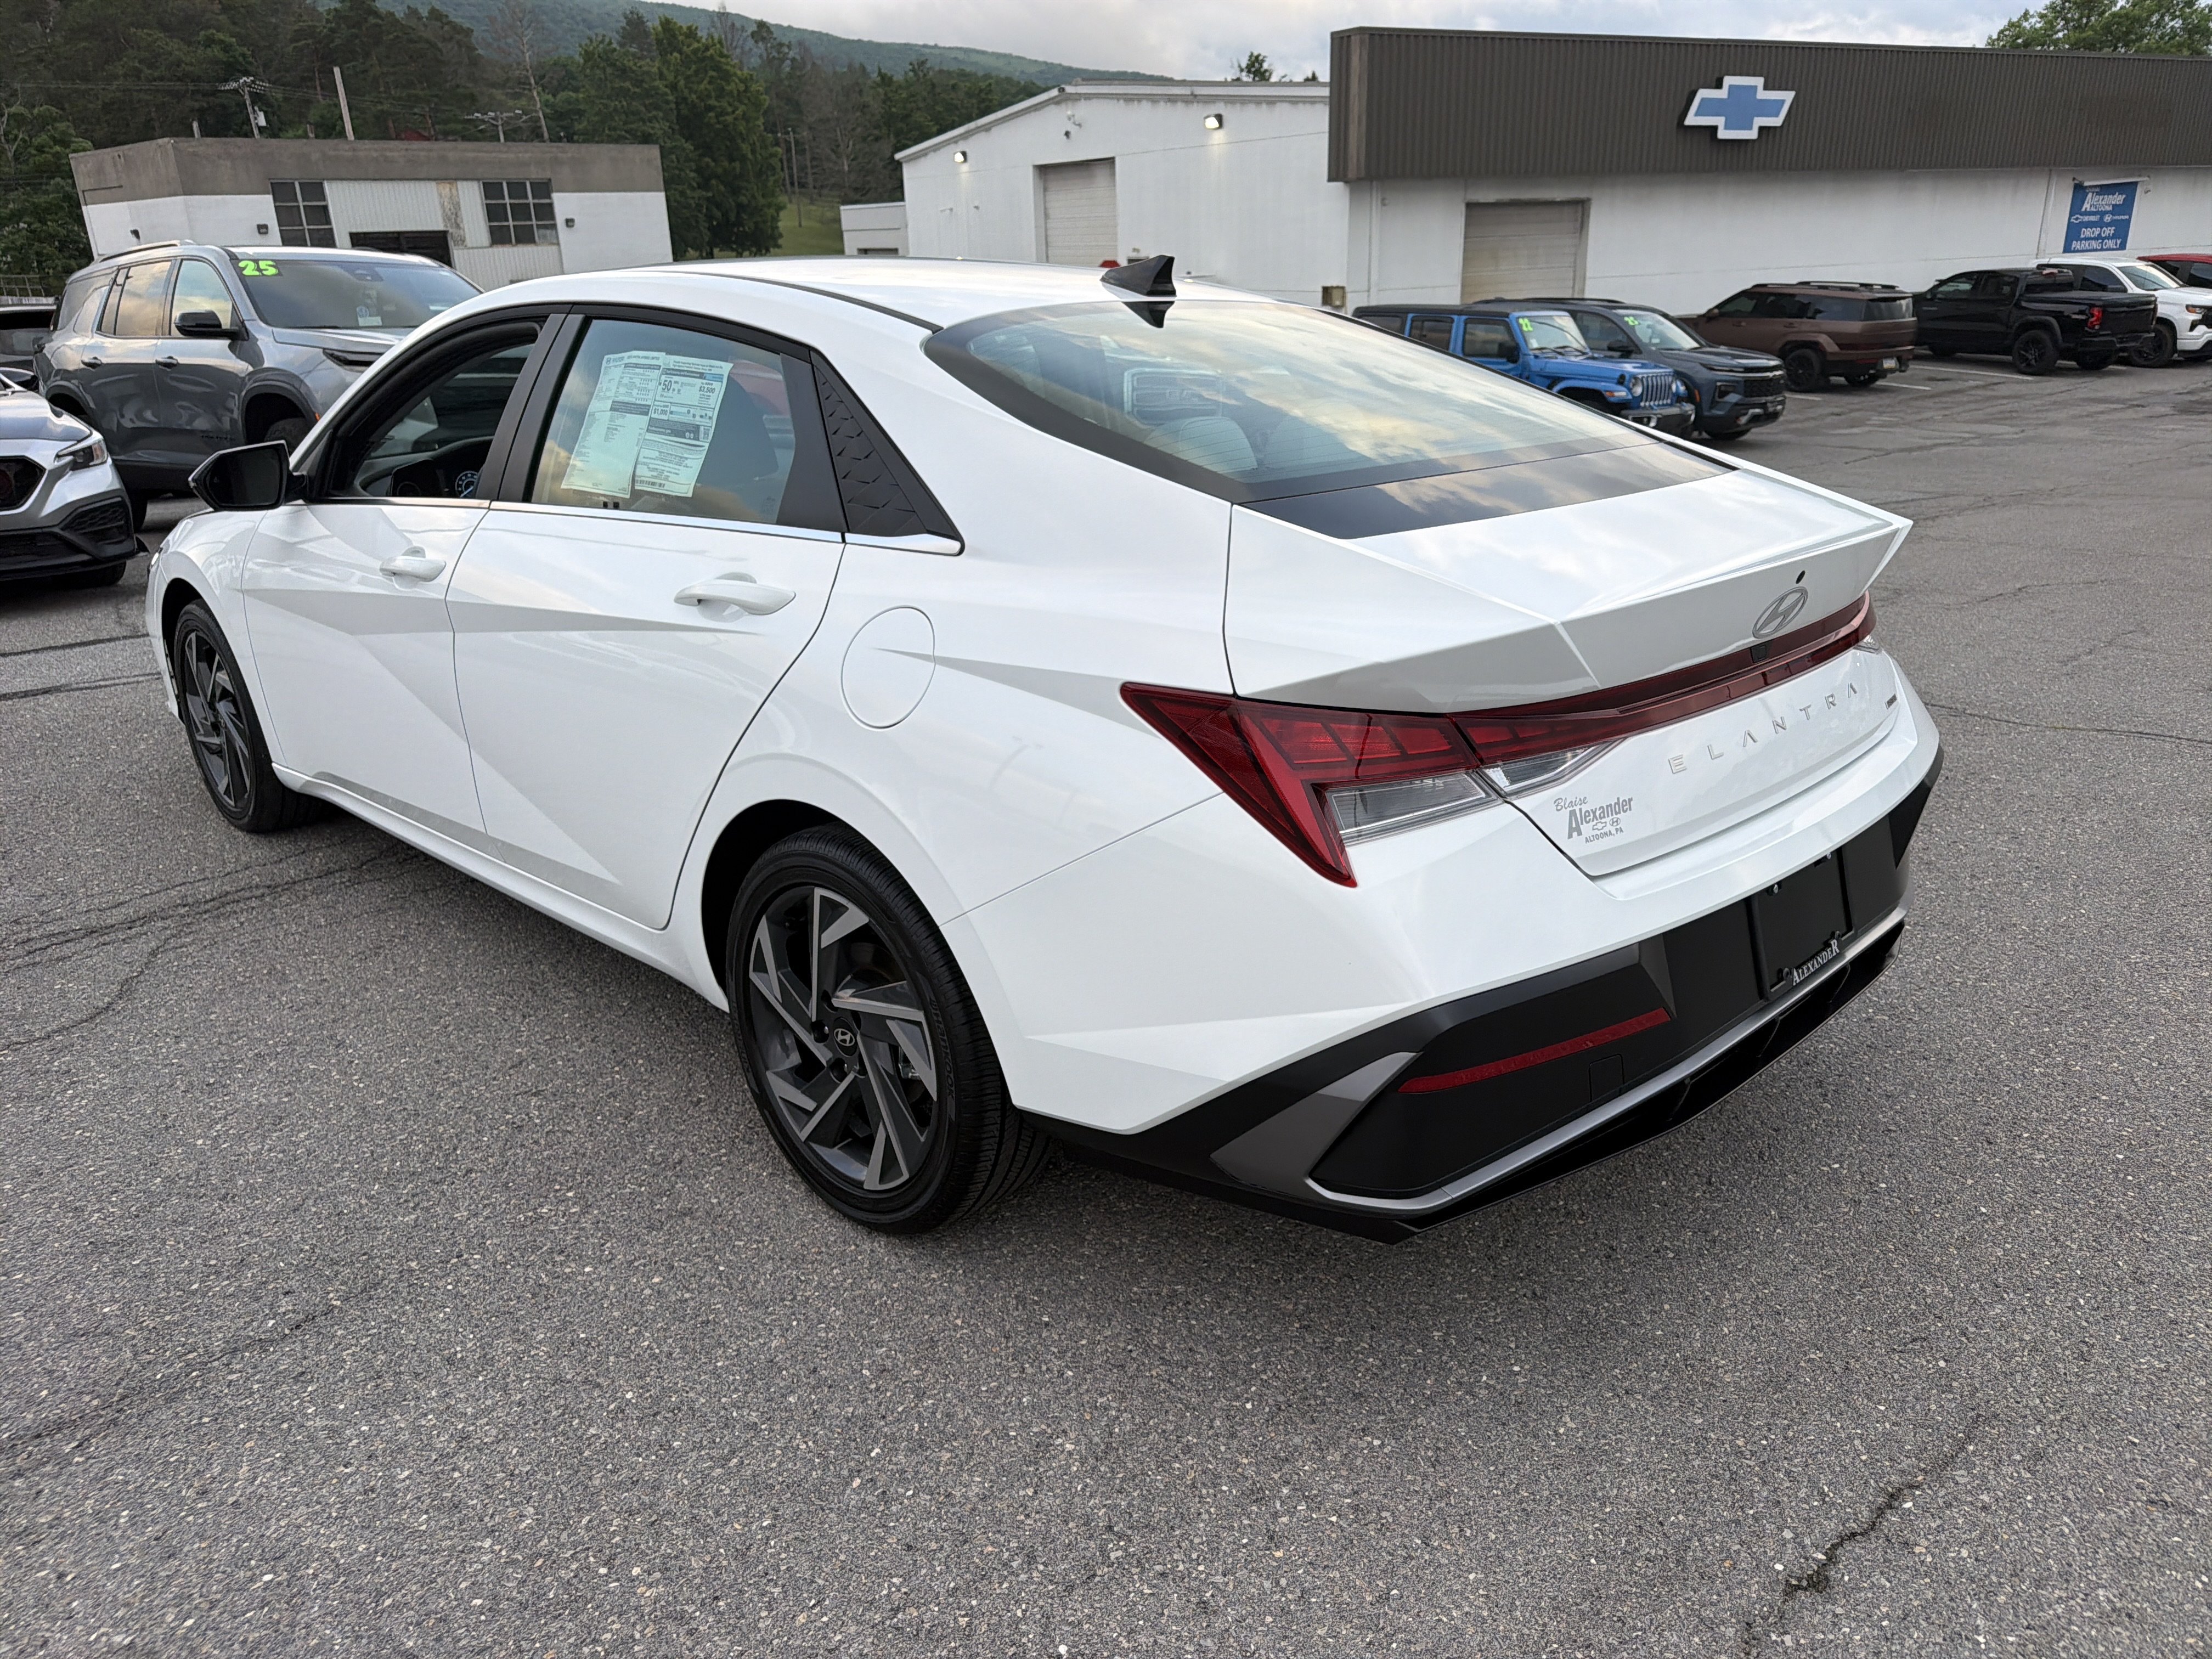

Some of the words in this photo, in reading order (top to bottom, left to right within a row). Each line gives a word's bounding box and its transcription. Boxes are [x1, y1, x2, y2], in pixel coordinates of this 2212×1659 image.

[2081, 192, 2126, 211] Alexander
[2081, 228, 2101, 238] DROP
[2101, 227, 2115, 237] OFF
[2072, 240, 2102, 250] PARKING
[2103, 239, 2121, 249] ONLY
[238, 260, 279, 276] 25
[662, 380, 673, 392] 50
[698, 386, 716, 394] $3,500
[1668, 682, 1858, 774] ELANTRA
[1553, 796, 1588, 812] Blaise
[1567, 797, 1633, 840] Alexander
[1585, 830, 1615, 844] ALTOONA,
[1616, 826, 1624, 835] PA
[1793, 939, 1840, 986] ALEXANDER
